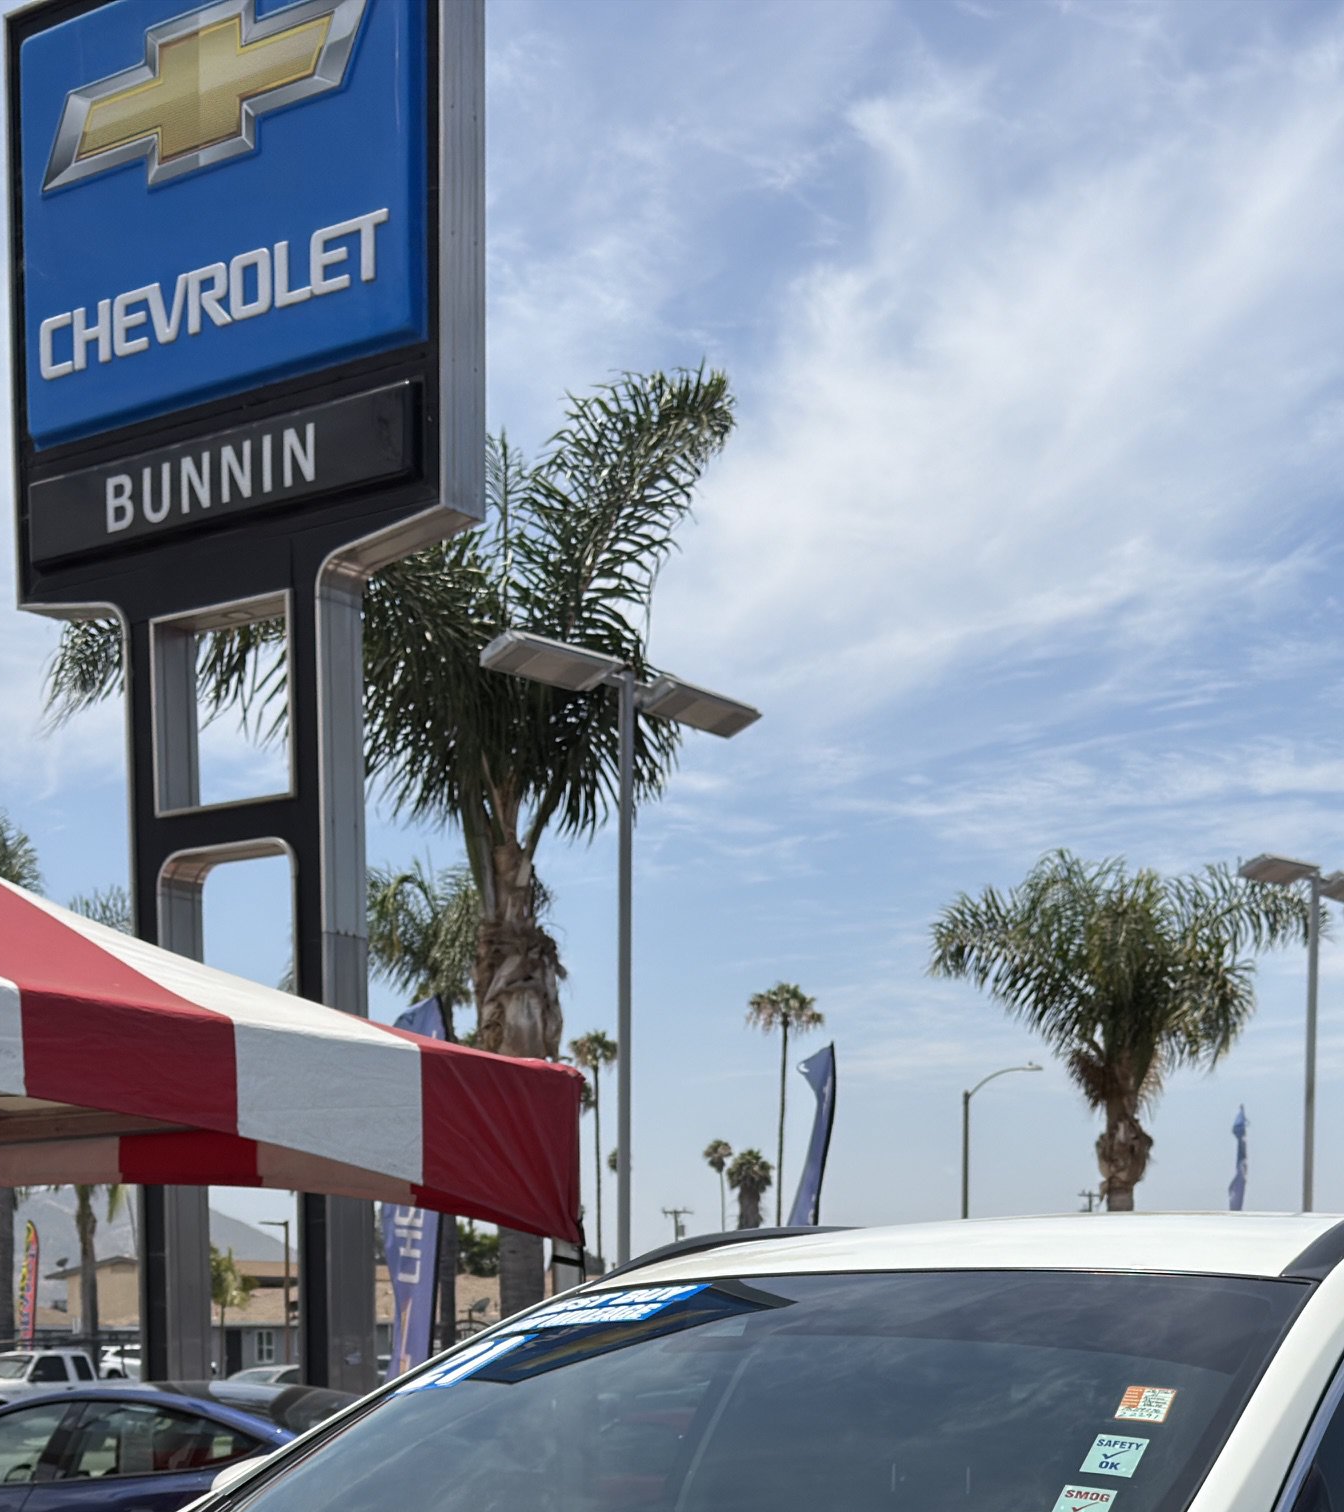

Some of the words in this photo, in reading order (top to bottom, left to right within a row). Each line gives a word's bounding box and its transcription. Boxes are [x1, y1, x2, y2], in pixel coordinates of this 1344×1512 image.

[39, 207, 390, 381] CHEVROLET
[106, 422, 317, 533] BUNNIN
[1096, 1438, 1143, 1451] SAFETY
[1098, 1460, 1120, 1471] OK
[1065, 1489, 1110, 1502] SMOG
